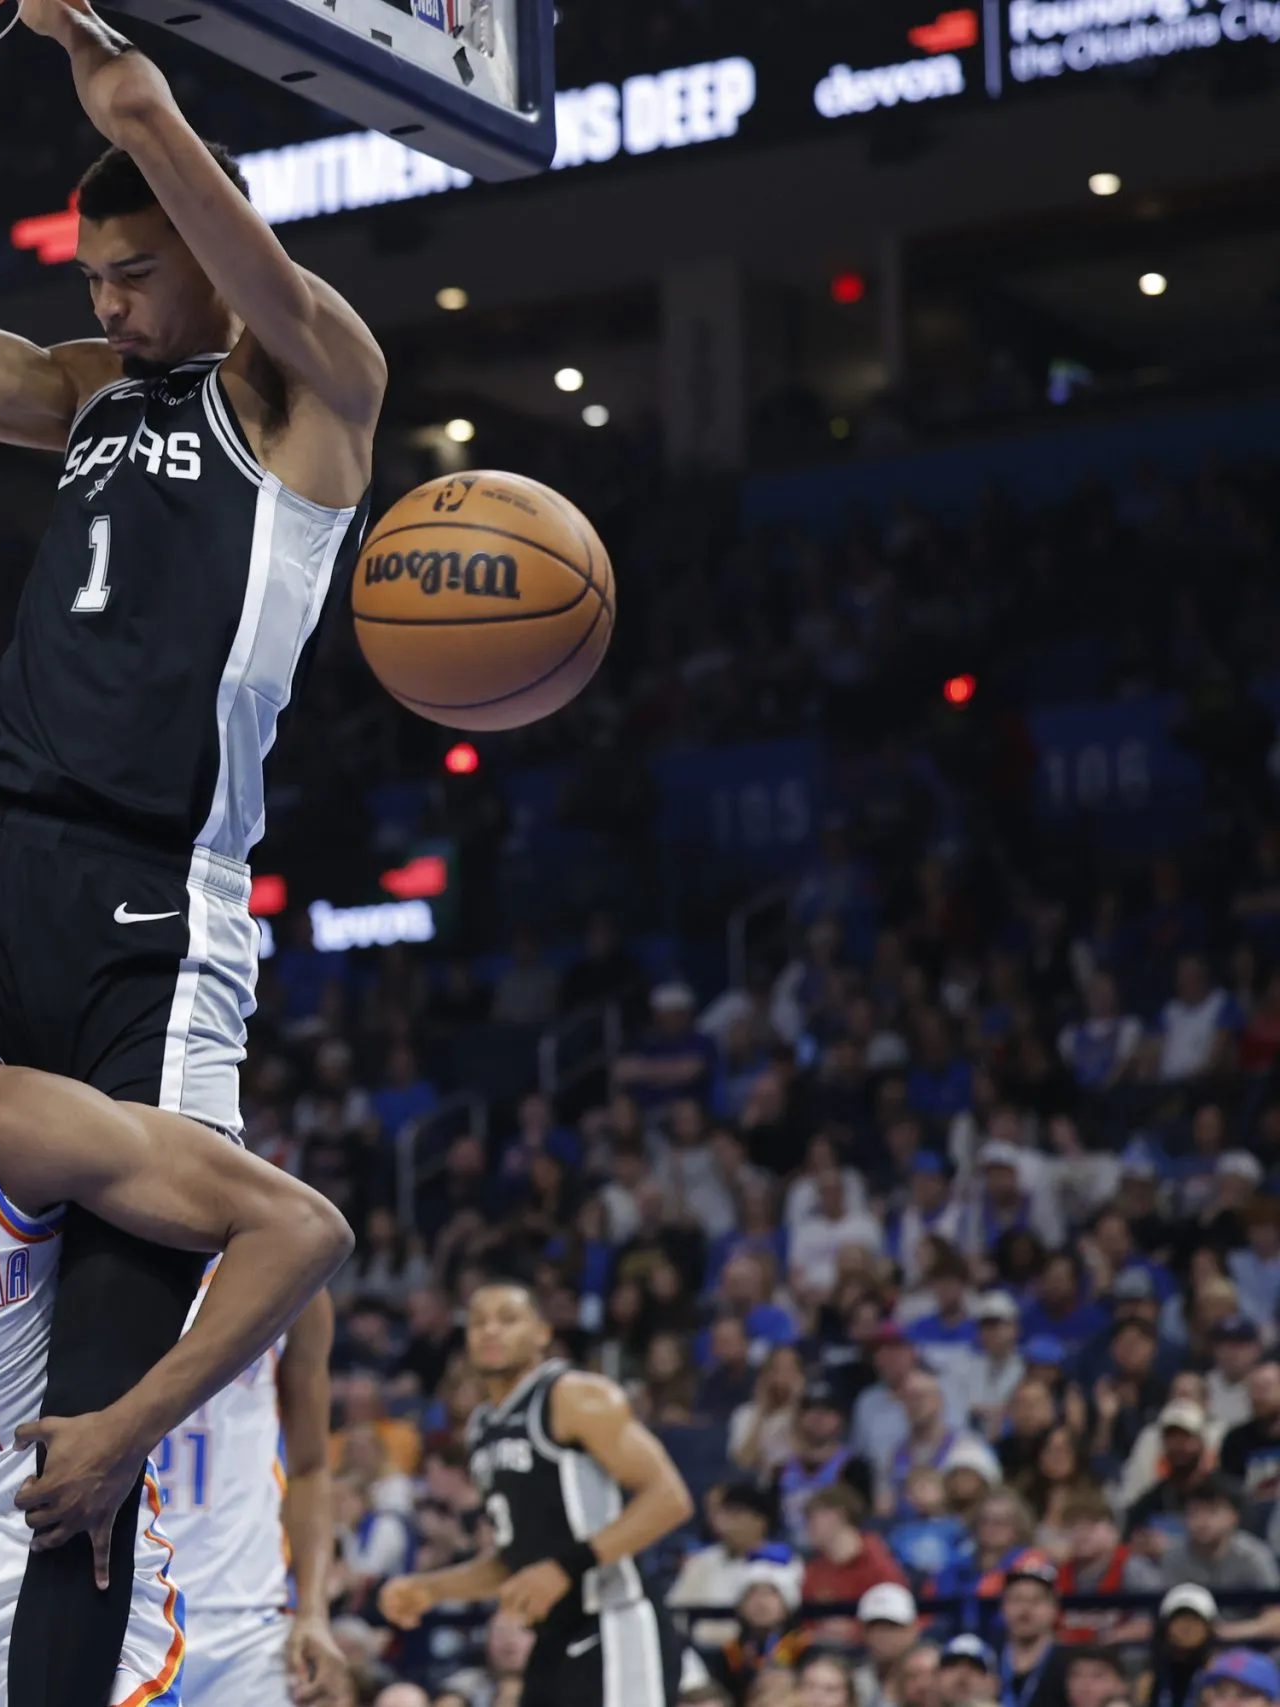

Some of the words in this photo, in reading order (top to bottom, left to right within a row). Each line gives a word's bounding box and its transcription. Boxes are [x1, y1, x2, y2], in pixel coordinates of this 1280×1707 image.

[624, 57, 756, 154] DEEP
[814, 54, 965, 117] devon
[70, 515, 111, 612] 1
[364, 549, 521, 600] Wilson
